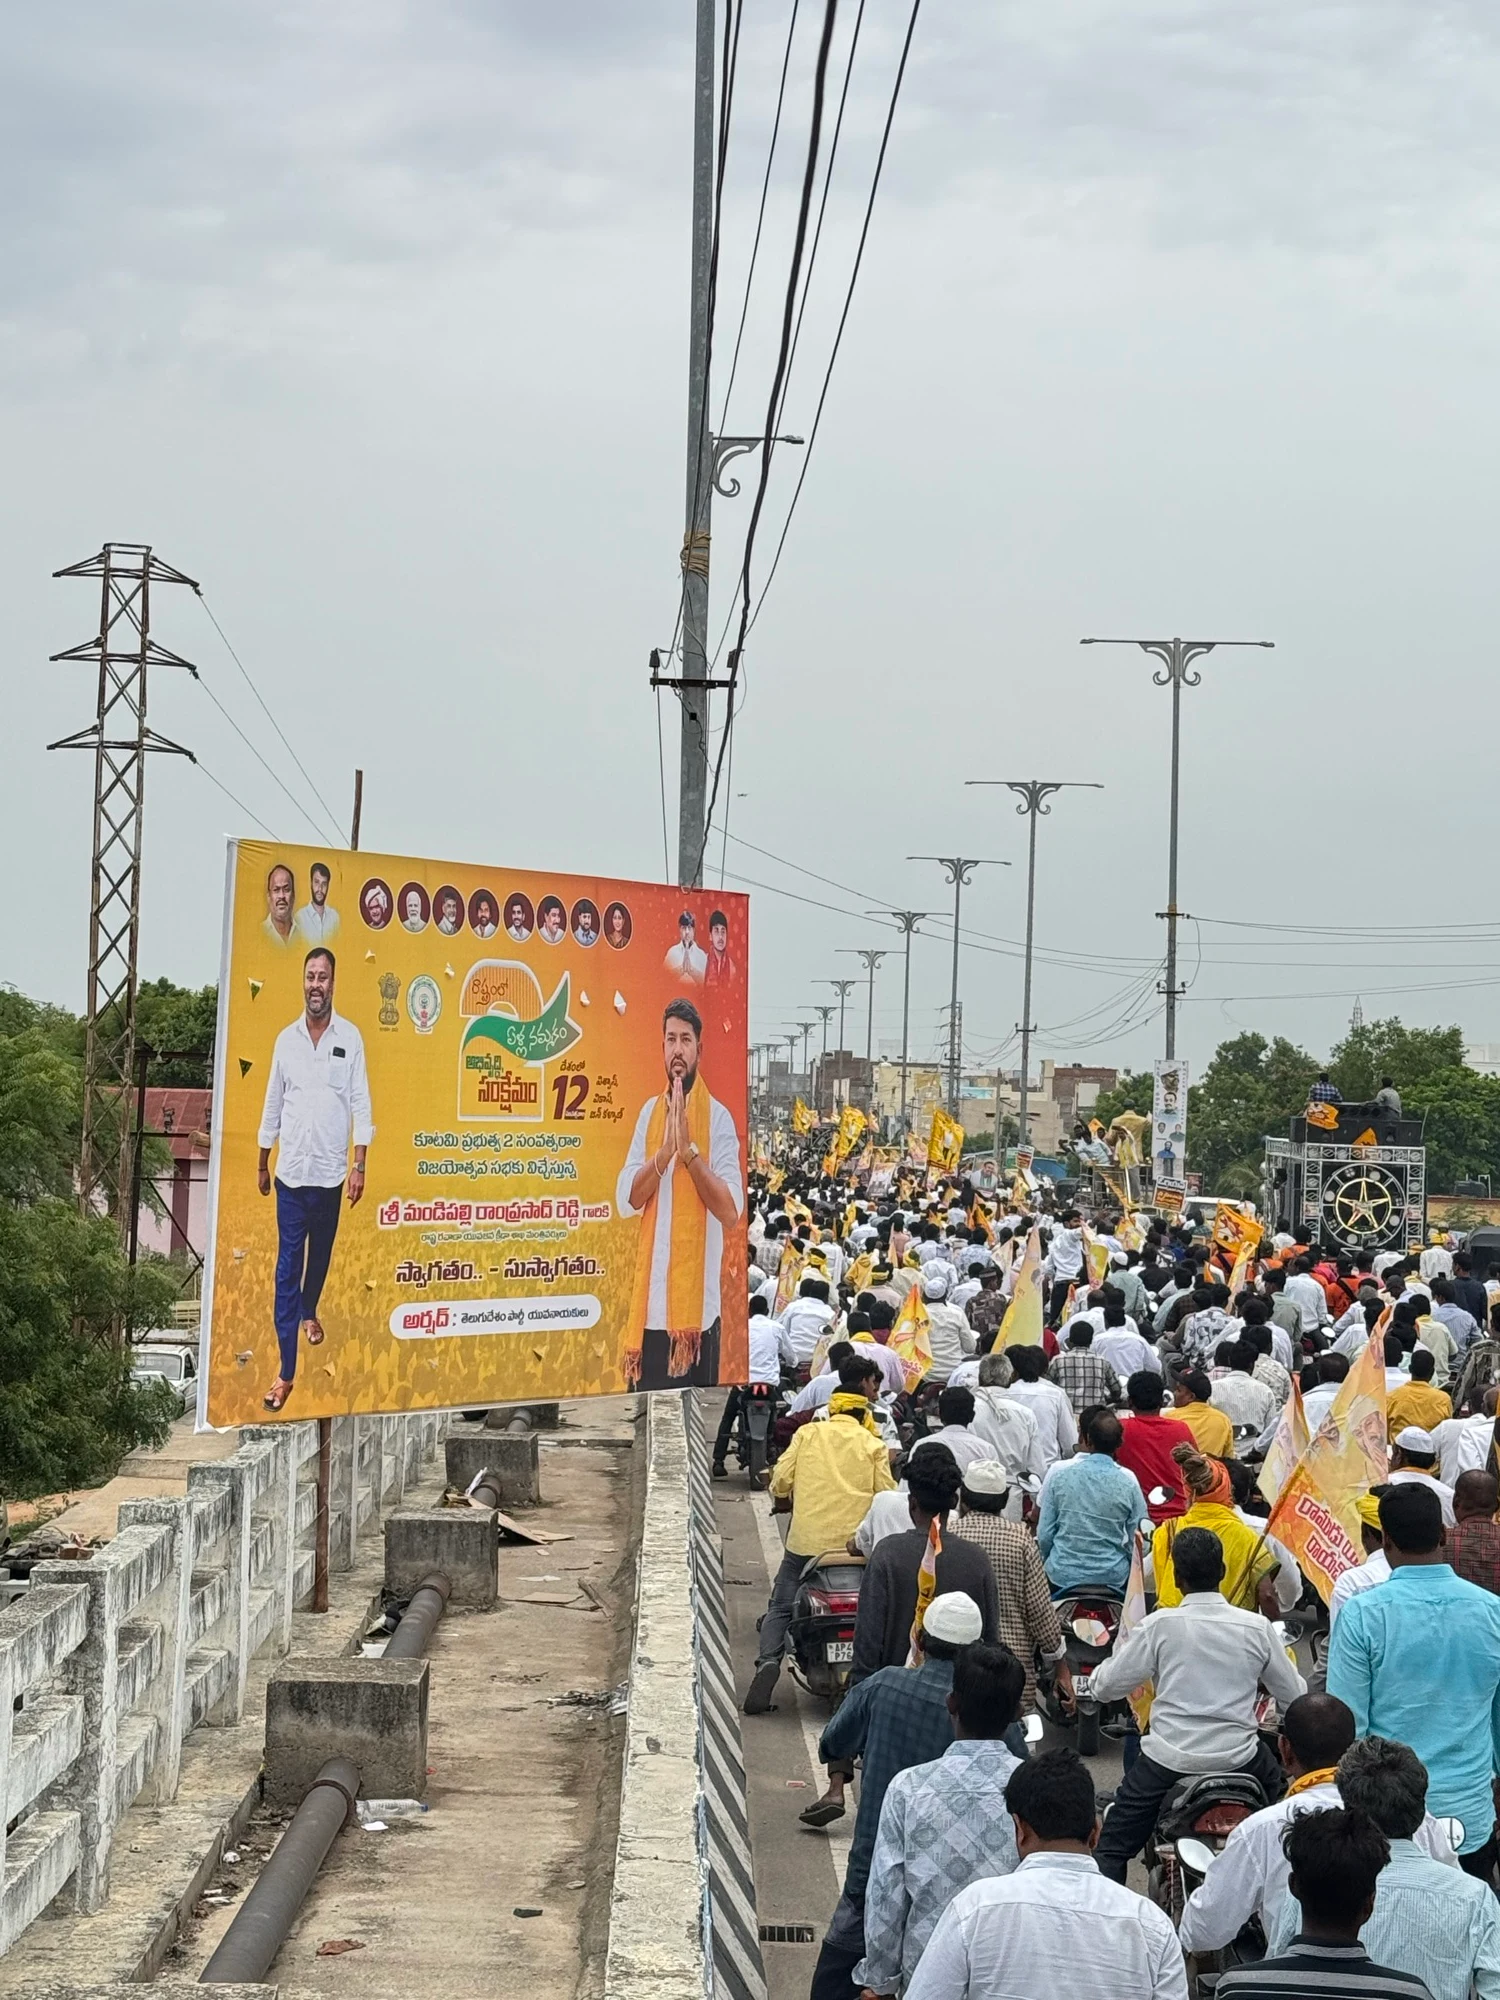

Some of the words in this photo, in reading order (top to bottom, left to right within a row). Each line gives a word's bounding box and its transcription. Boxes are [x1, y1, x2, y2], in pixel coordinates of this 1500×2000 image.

[529, 1018, 568, 1052] నమ్మకం
[478, 1071, 538, 1113] సంక్షేమం
[552, 1074, 590, 1120] 12
[413, 1132, 459, 1148] కూటమి
[461, 1132, 500, 1152] ప్రభుత్వ
[503, 1133, 514, 1148] 2
[516, 1132, 582, 1152] సంవత్సరాల
[417, 1160, 488, 1179] విజయోత్సవ
[490, 1160, 524, 1177] సభకు
[526, 1157, 577, 1180] విచ్చేస్తున్న
[380, 1200, 400, 1226] శ్రీ
[403, 1201, 472, 1226] మండిపల్లి
[475, 1199, 553, 1222] రాంప్రసాద్
[556, 1199, 579, 1227] రెడ్డి
[582, 1204, 609, 1218] గారికి
[461, 1309, 506, 1324] తెలుగుదేశం
[835, 1651, 853, 1660] P76
